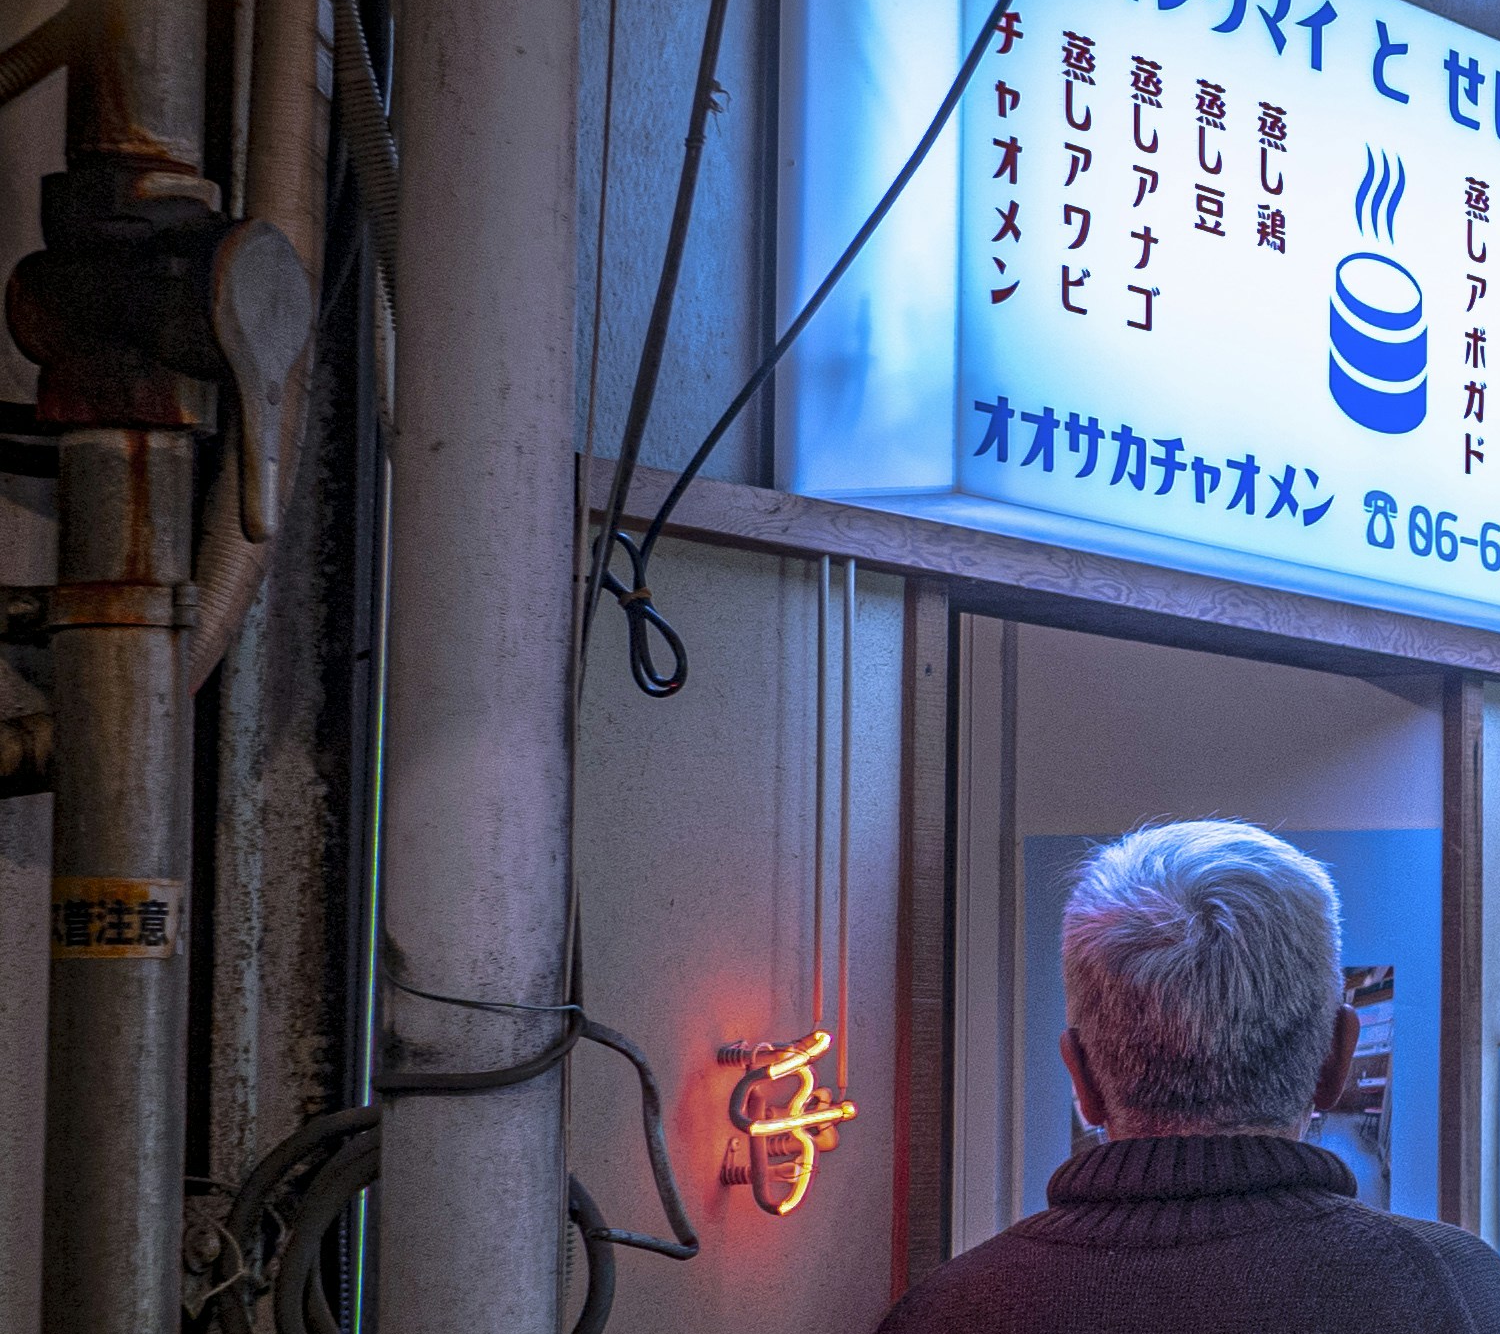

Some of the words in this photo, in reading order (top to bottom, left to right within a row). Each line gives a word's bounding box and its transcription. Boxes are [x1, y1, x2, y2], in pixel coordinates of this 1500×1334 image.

[991, 11, 1024, 306] チャオメン
[1194, 78, 1227, 238] 蒸し豆
[1373, 19, 1410, 105] と
[1061, 30, 1097, 317] 蒸しアワビ
[1126, 55, 1164, 333] 蒸しアナゴ
[1256, 100, 1288, 256] 蒸し鶏
[1463, 176, 1491, 476] 蒸しアボガド
[973, 395, 1336, 529] オオサカチャオメン
